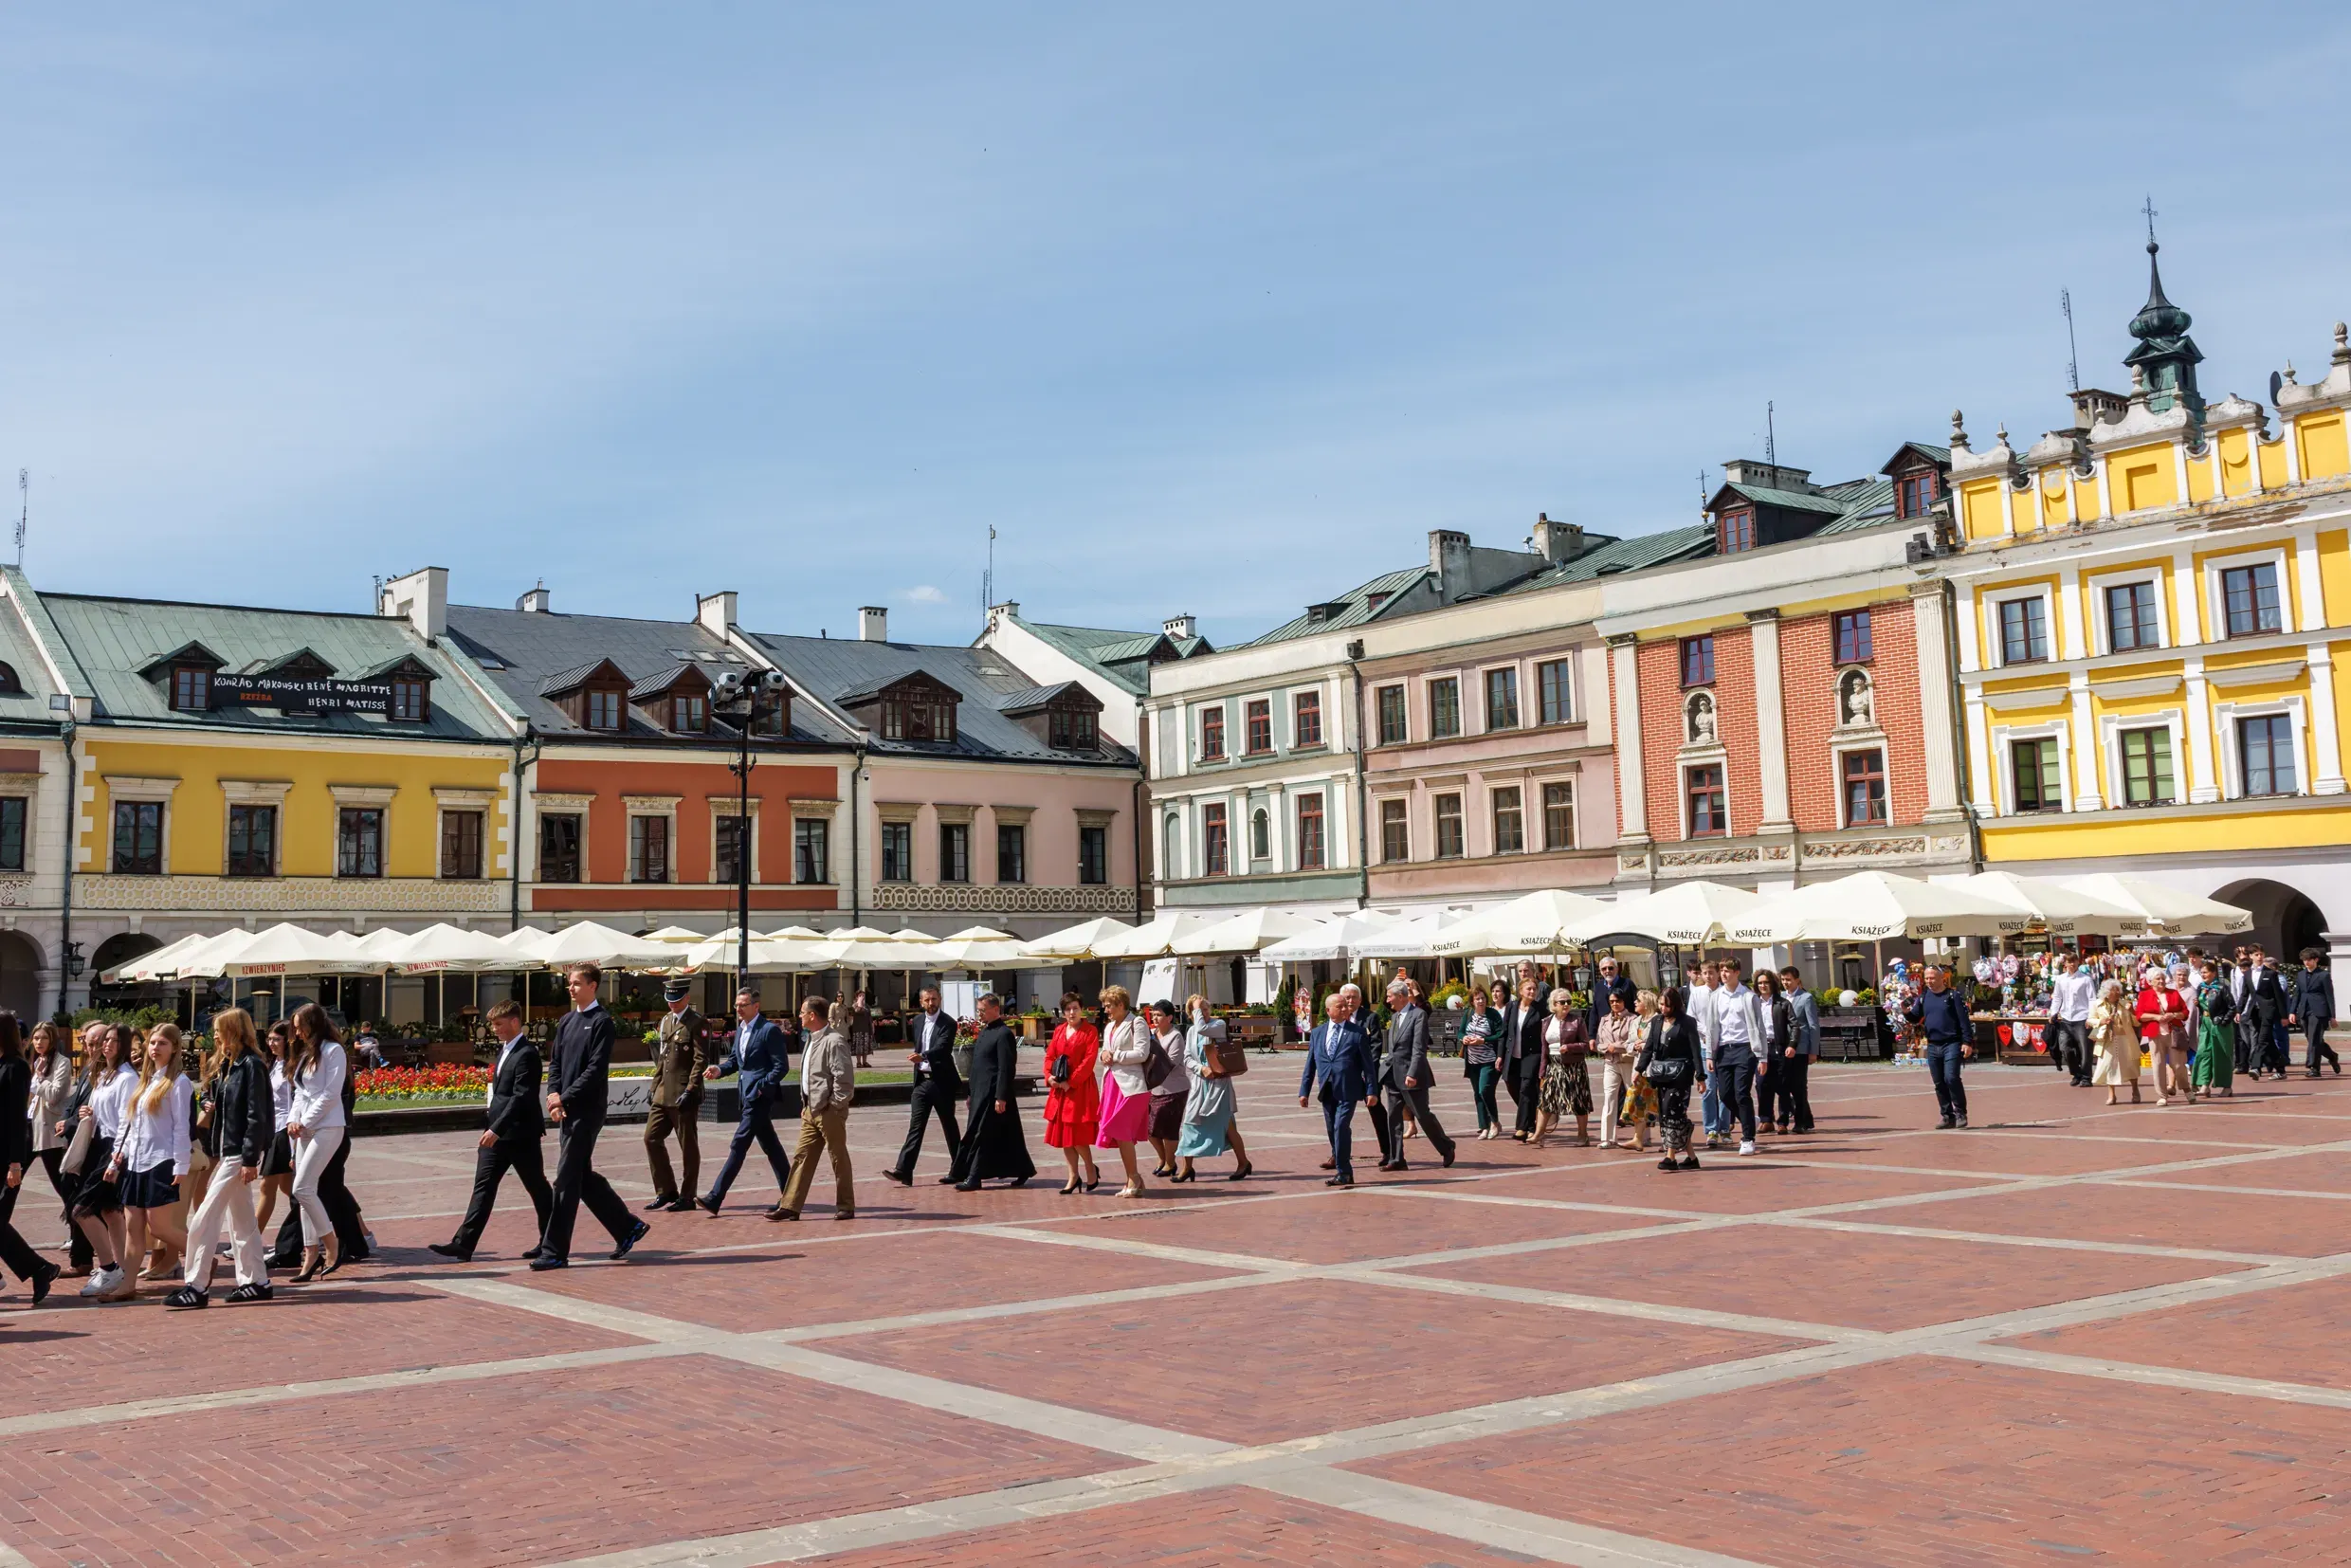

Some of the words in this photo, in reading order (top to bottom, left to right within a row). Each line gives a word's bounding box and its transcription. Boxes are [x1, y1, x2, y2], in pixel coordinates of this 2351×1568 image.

[213, 677, 253, 688] KONRAD
[258, 679, 304, 692] MAKOWSKI
[306, 680, 332, 691] RENÉ
[337, 684, 391, 695] MAGRITTE
[308, 698, 340, 707] HENRI
[346, 699, 387, 710] MATISSE
[1667, 929, 1703, 941] KSIĄŻĘCE
[1736, 928, 1772, 939] KSIĄŻĘCE
[1432, 940, 1461, 952] KSIĄŻĘCE
